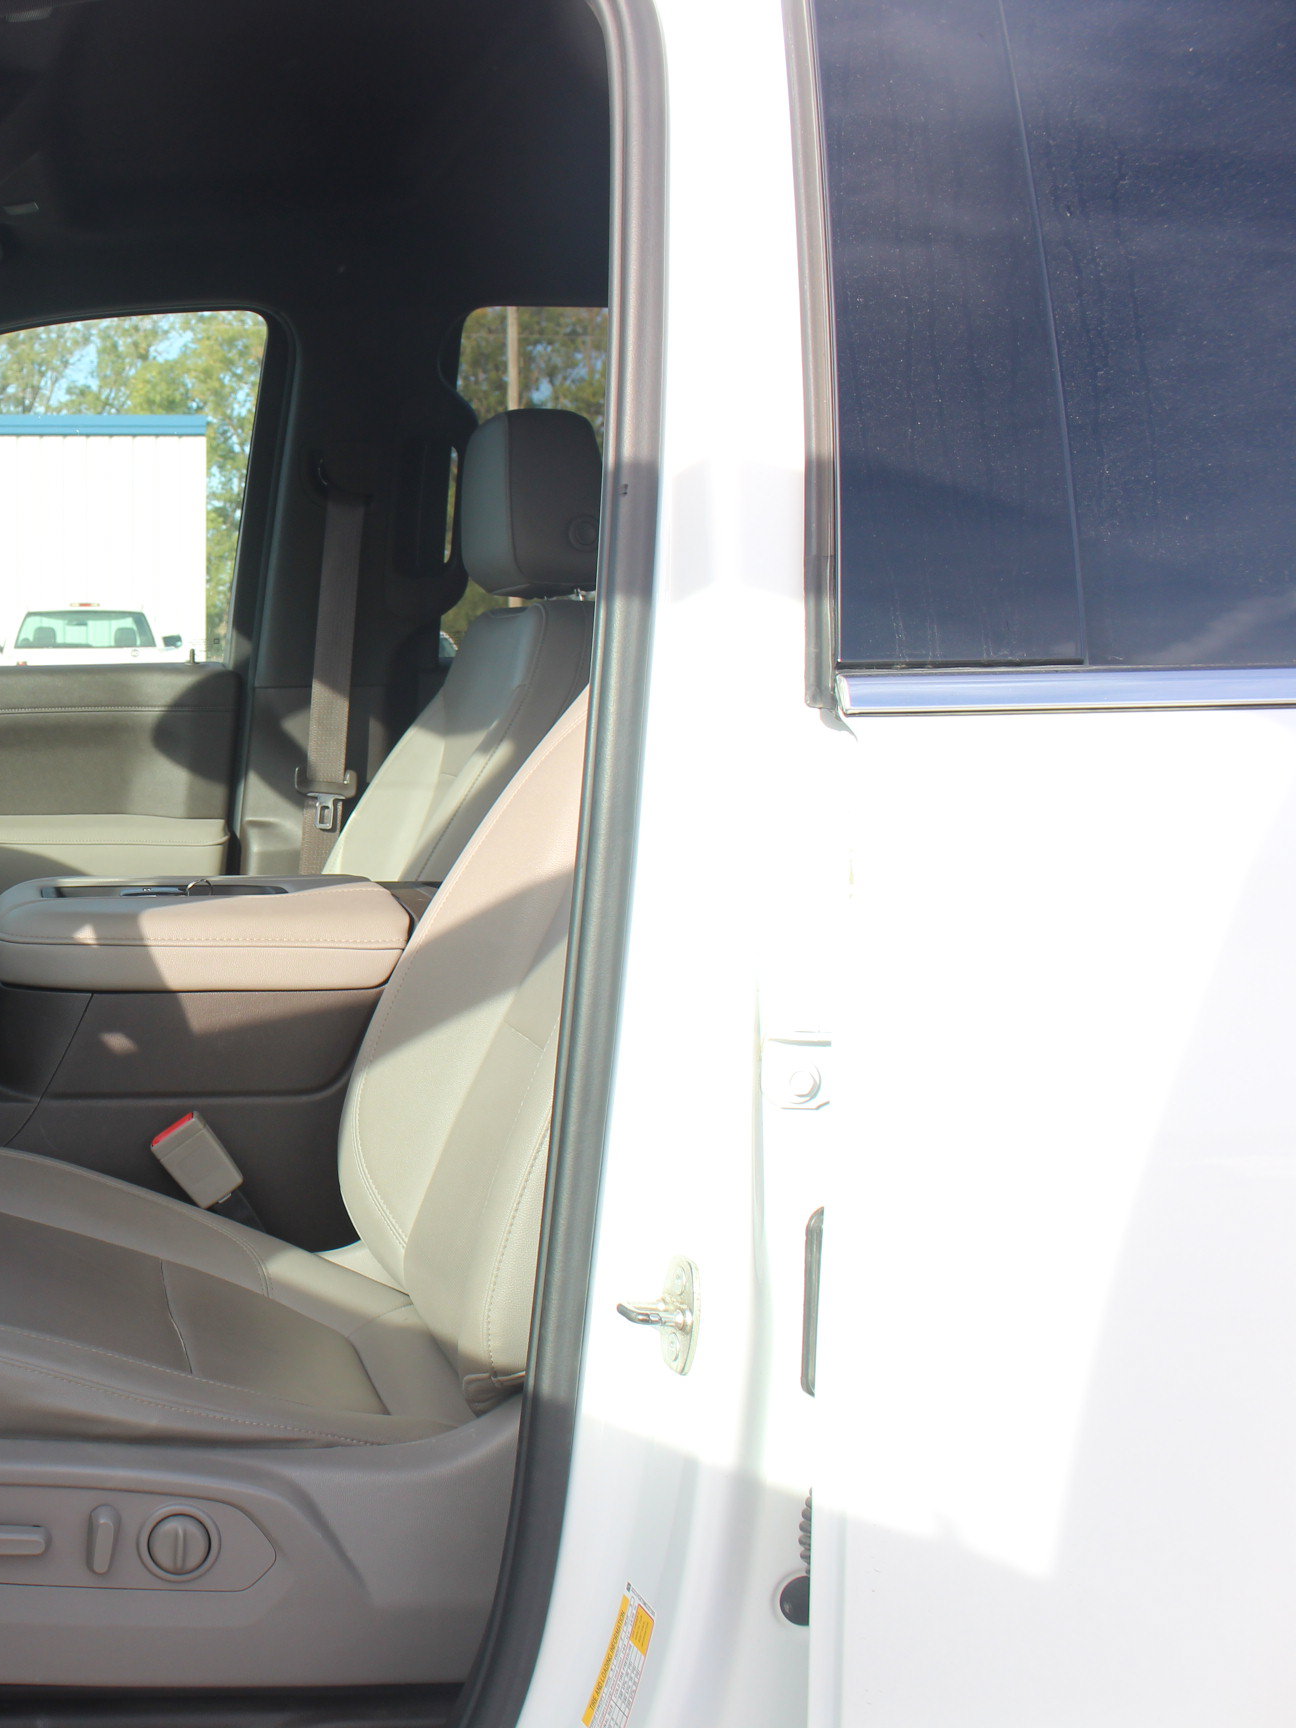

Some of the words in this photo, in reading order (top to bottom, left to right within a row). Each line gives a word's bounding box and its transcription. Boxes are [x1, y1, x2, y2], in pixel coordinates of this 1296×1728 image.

[589, 1695, 599, 1710] TIRE
[594, 1681, 604, 1696] AND
[599, 1652, 612, 1683] LOADING
[608, 1609, 625, 1653] INFORMATION
